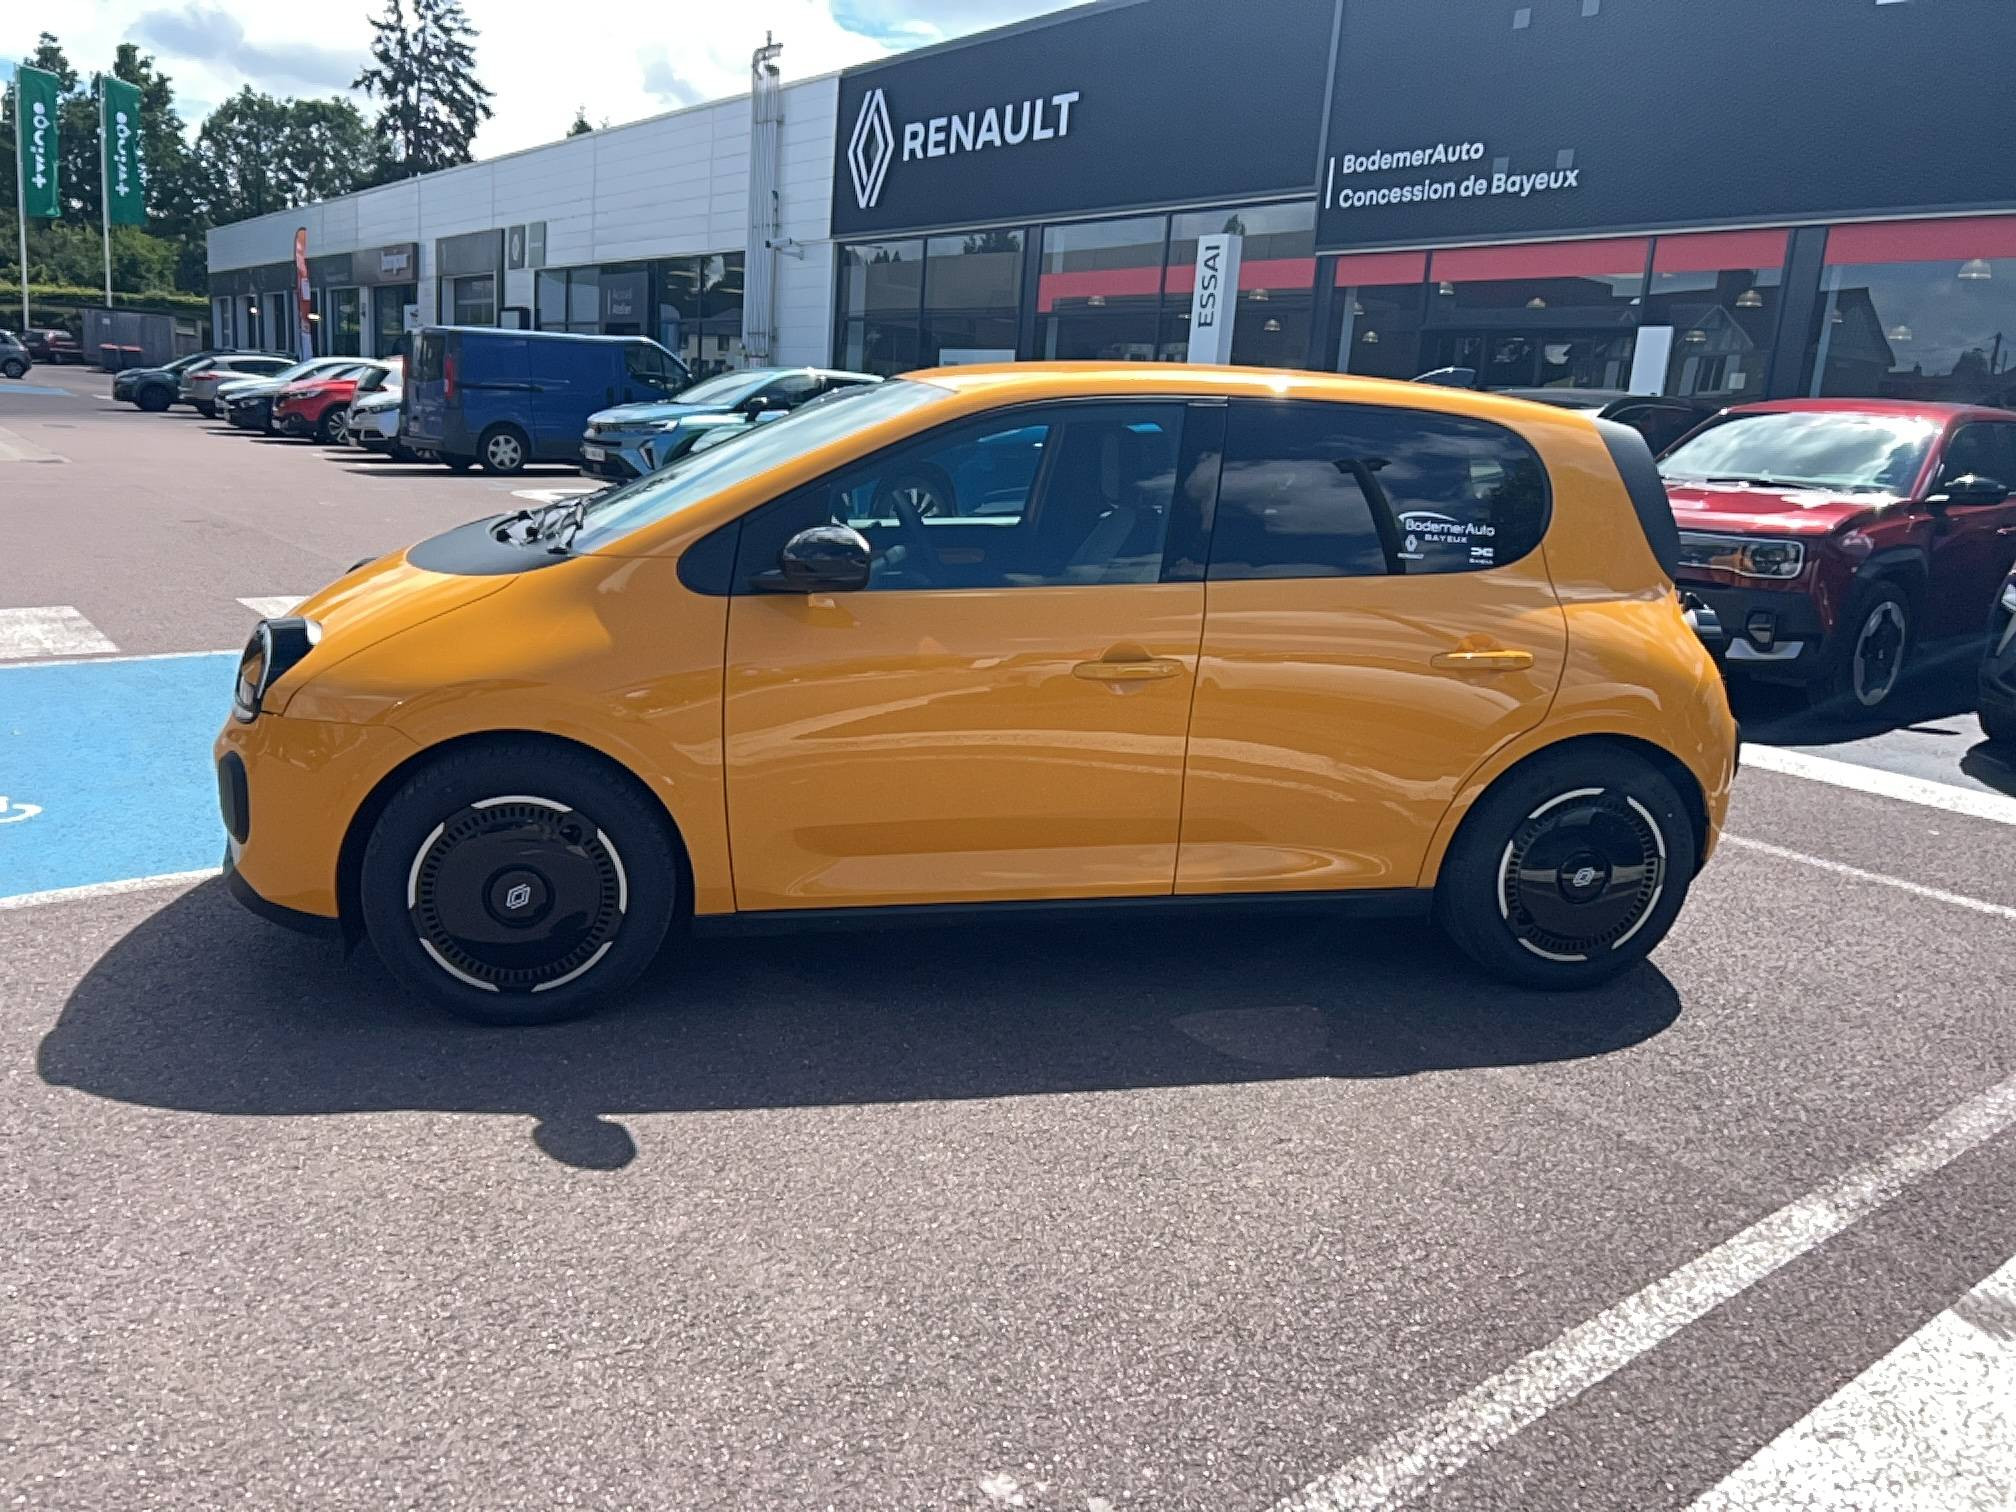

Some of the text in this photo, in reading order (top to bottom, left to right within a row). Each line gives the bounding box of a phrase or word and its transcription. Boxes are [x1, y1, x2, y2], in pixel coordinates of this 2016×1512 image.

[903, 91, 1079, 161] RENAULT
[1342, 141, 1485, 175] BodemerAuto
[1338, 168, 1580, 209] Concession de Bayeux
[1197, 244, 1221, 329] ESSAI
[1405, 519, 1495, 536] BodemerAuto
